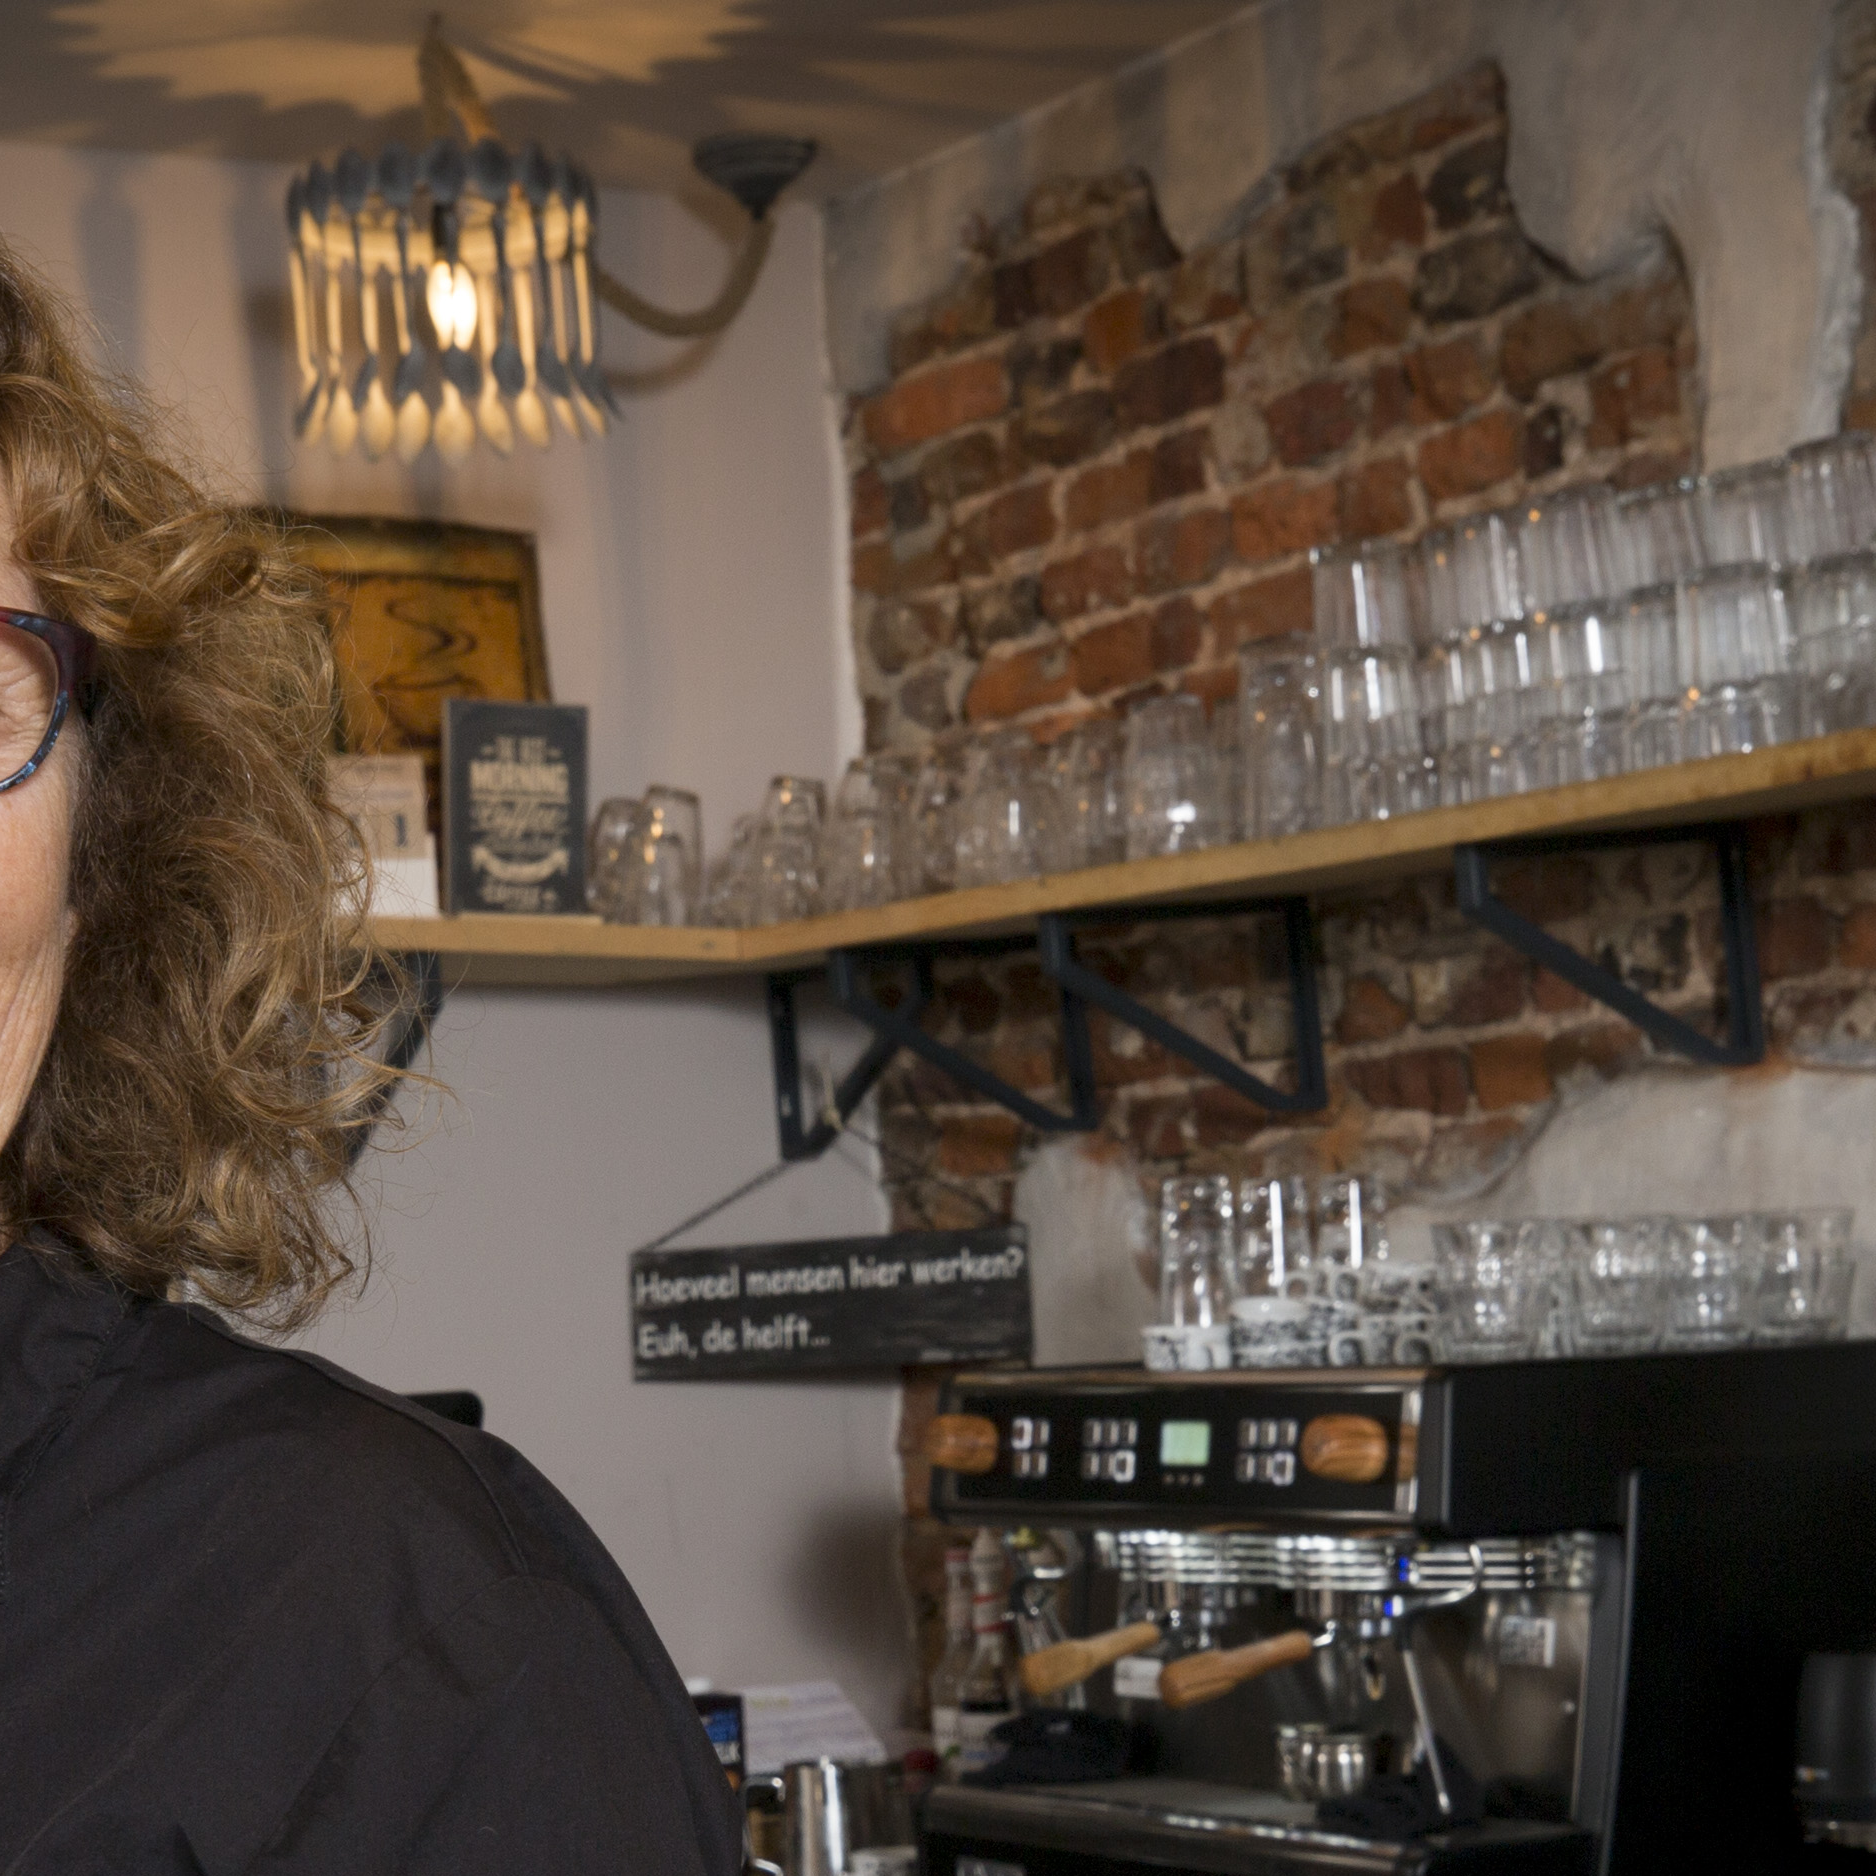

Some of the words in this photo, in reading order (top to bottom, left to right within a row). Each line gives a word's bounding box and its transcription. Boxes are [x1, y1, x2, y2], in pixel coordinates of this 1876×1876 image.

[635, 1265, 740, 1306] Hoeveel
[745, 1262, 846, 1298] mensen
[848, 1253, 907, 1289] hier
[911, 1245, 1024, 1285] werken?
[637, 1321, 700, 1361] Euh,
[702, 1320, 739, 1354] de
